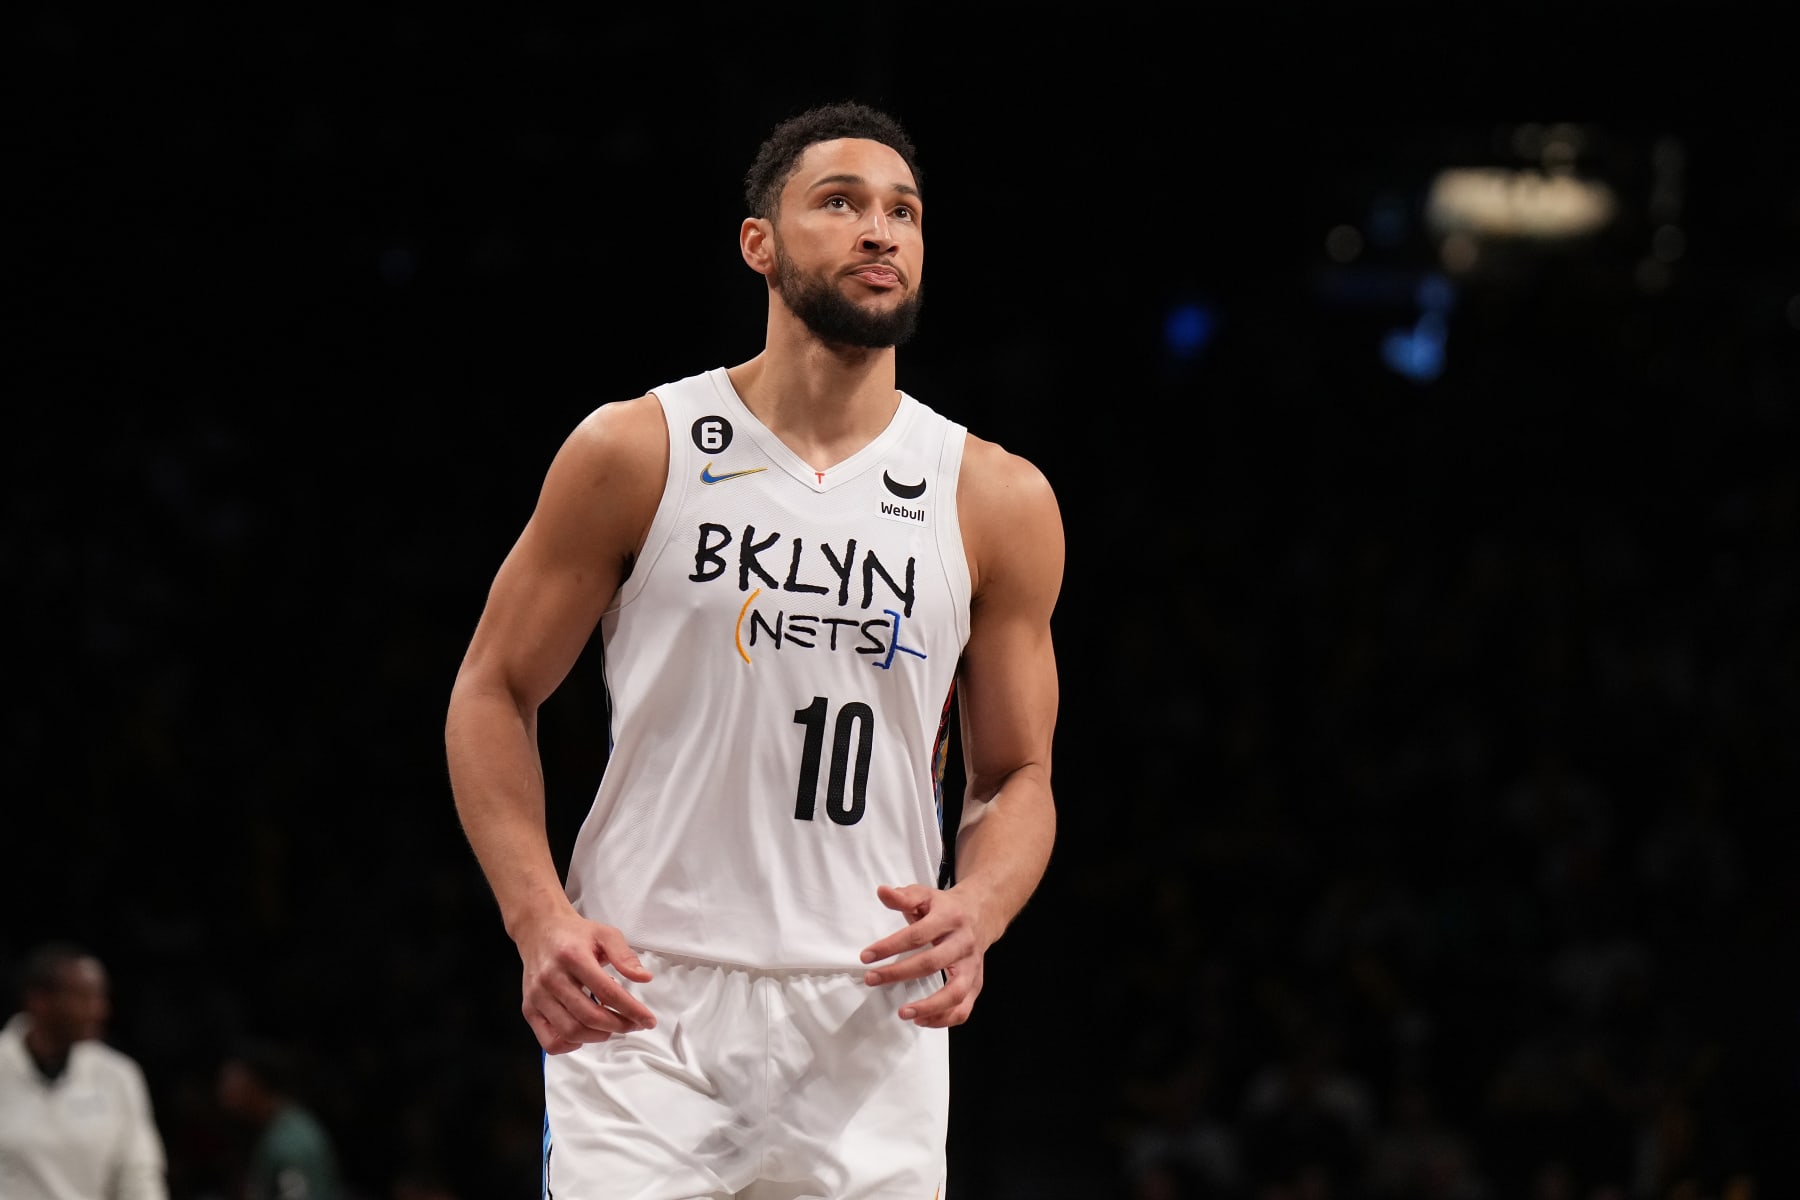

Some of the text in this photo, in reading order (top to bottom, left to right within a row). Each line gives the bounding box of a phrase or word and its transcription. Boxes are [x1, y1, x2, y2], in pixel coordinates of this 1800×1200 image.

[701, 421, 723, 450] 6
[880, 501, 925, 522] Webull
[688, 522, 916, 618] BKLYN
[793, 696, 875, 826] 10
